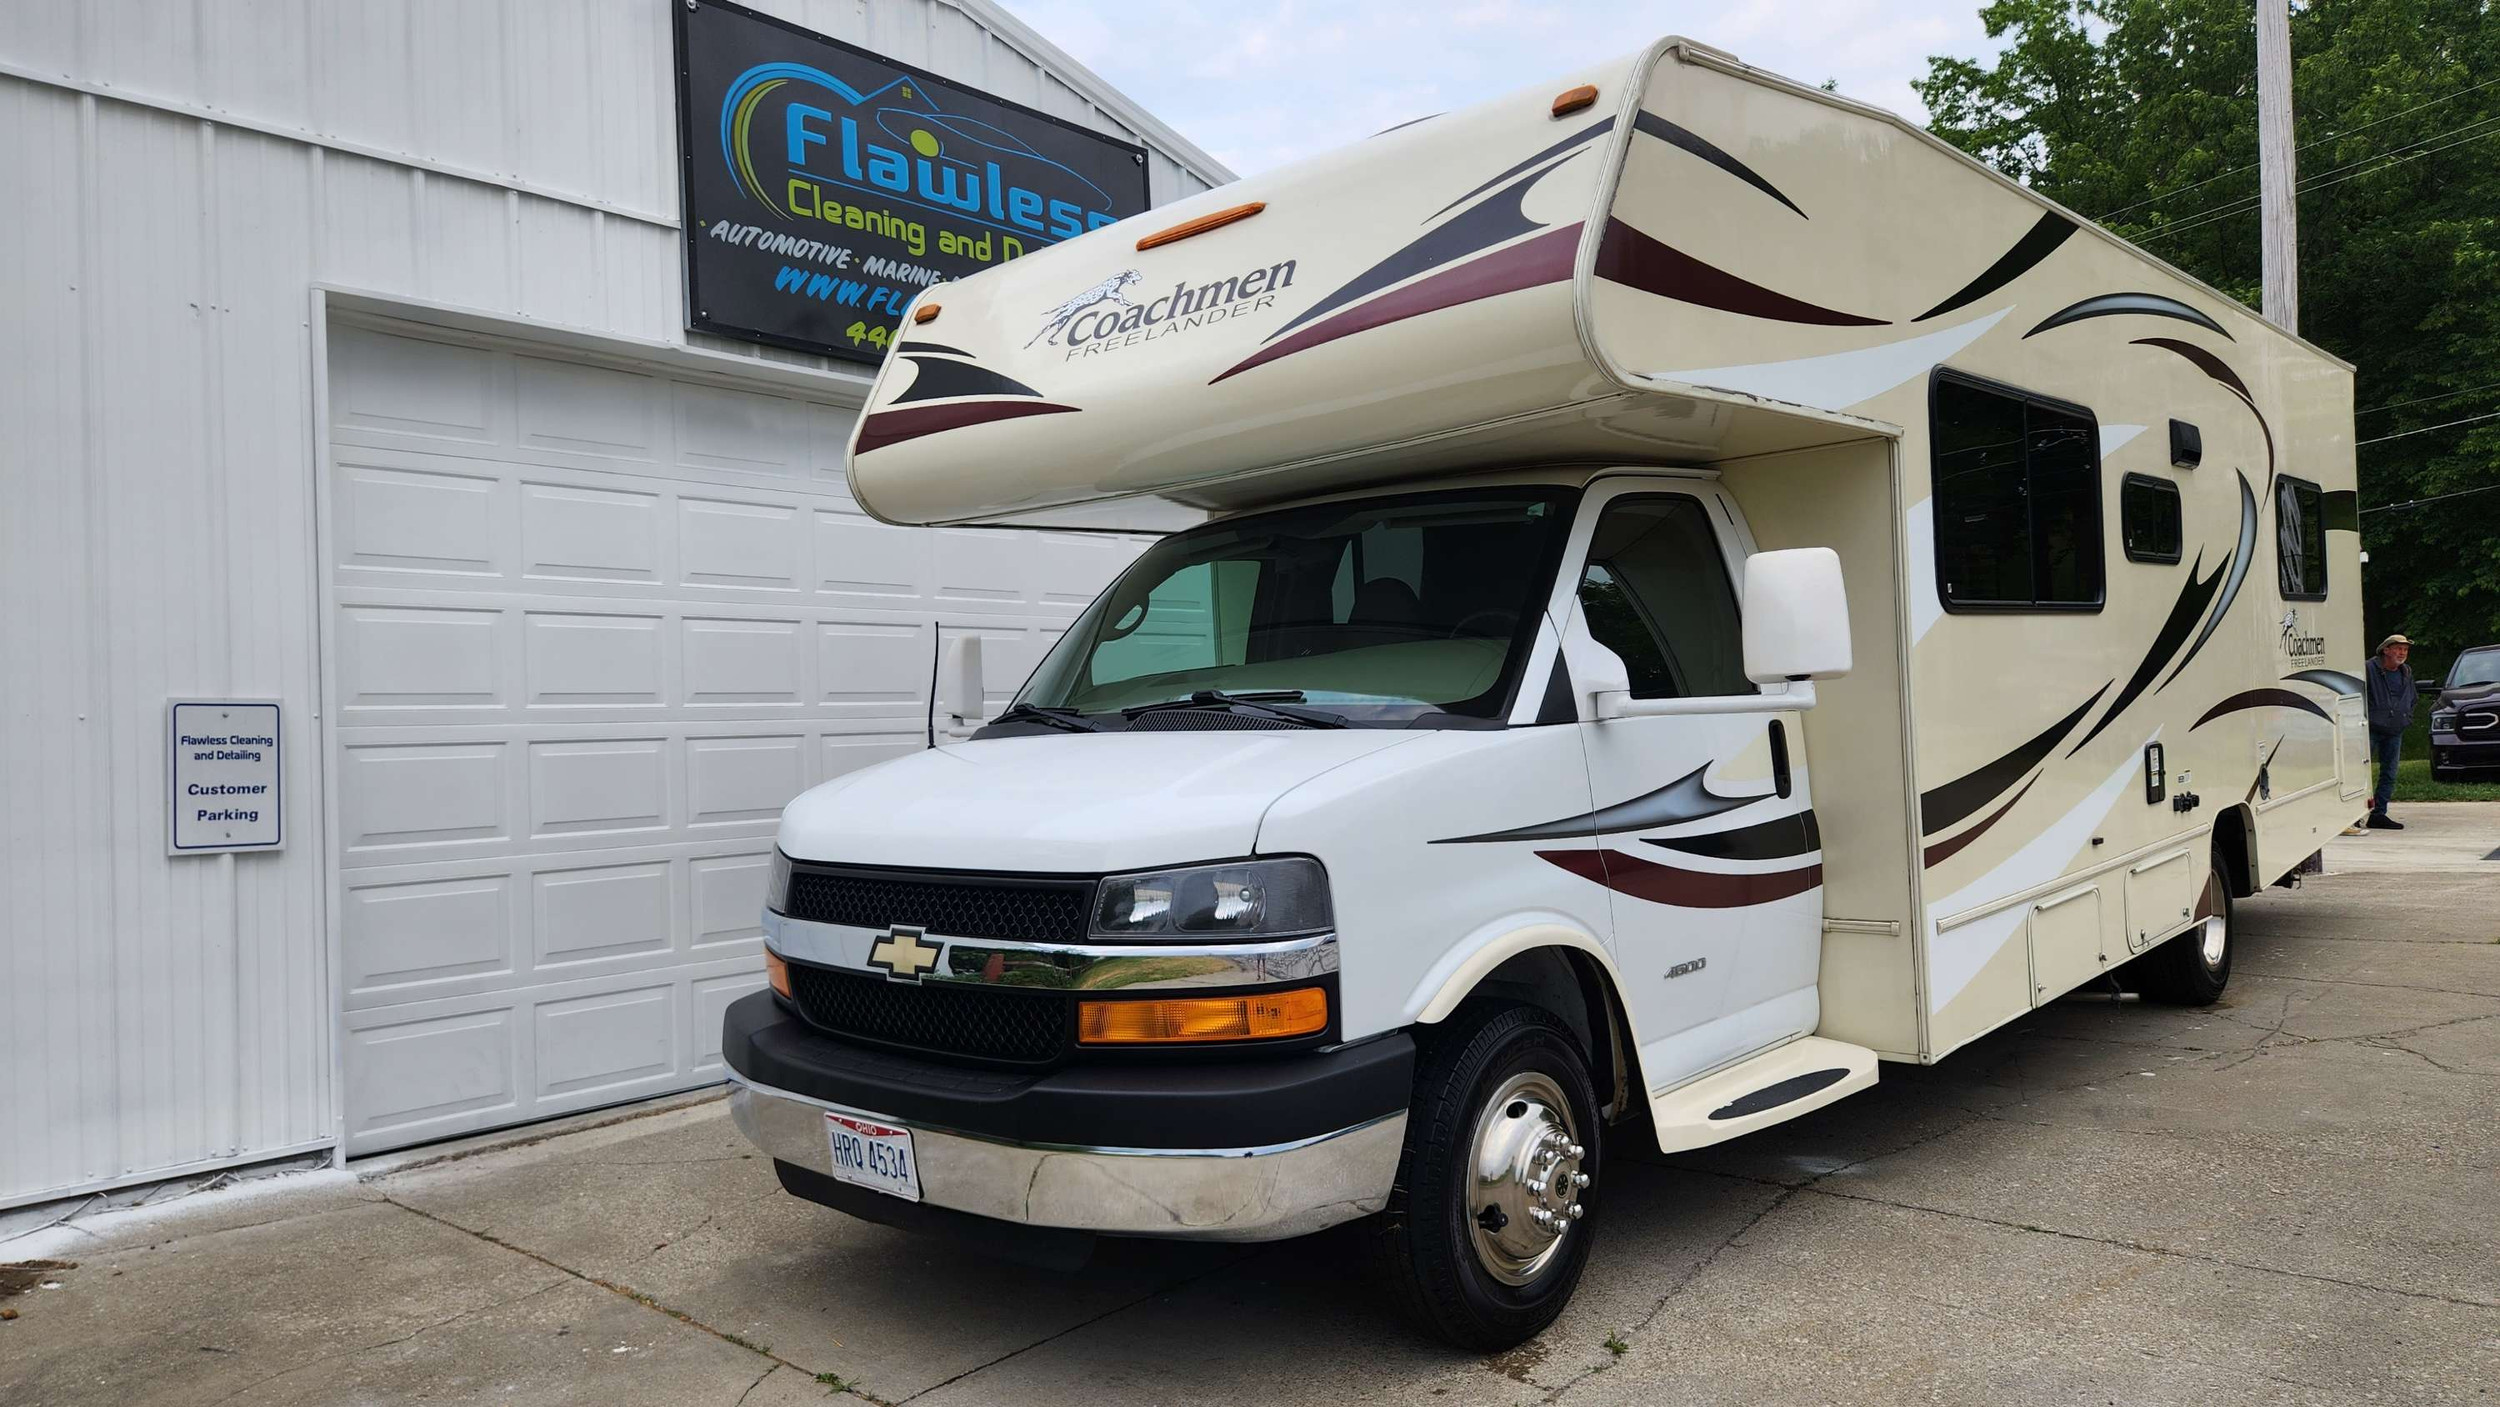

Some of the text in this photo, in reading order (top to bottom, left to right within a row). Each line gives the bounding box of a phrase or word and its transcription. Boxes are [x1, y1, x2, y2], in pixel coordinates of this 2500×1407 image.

[787, 178, 927, 256] Cleaning
[939, 230, 992, 262] and
[710, 219, 942, 287] AUTOMOTIVE MARINE
[1066, 259, 1297, 347] Coachmen
[1065, 294, 1275, 362] FREELANDER
[2288, 631, 2325, 657] Coachmen
[2291, 656, 2325, 668] FREELANDER
[181, 735, 273, 747] Flawless Cleaning
[194, 750, 261, 762] and Detailing
[188, 784, 268, 796] Customer
[197, 808, 259, 822] Parking
[855, 1122, 877, 1136] OHIO
[832, 1132, 908, 1182] HRQ 4534
